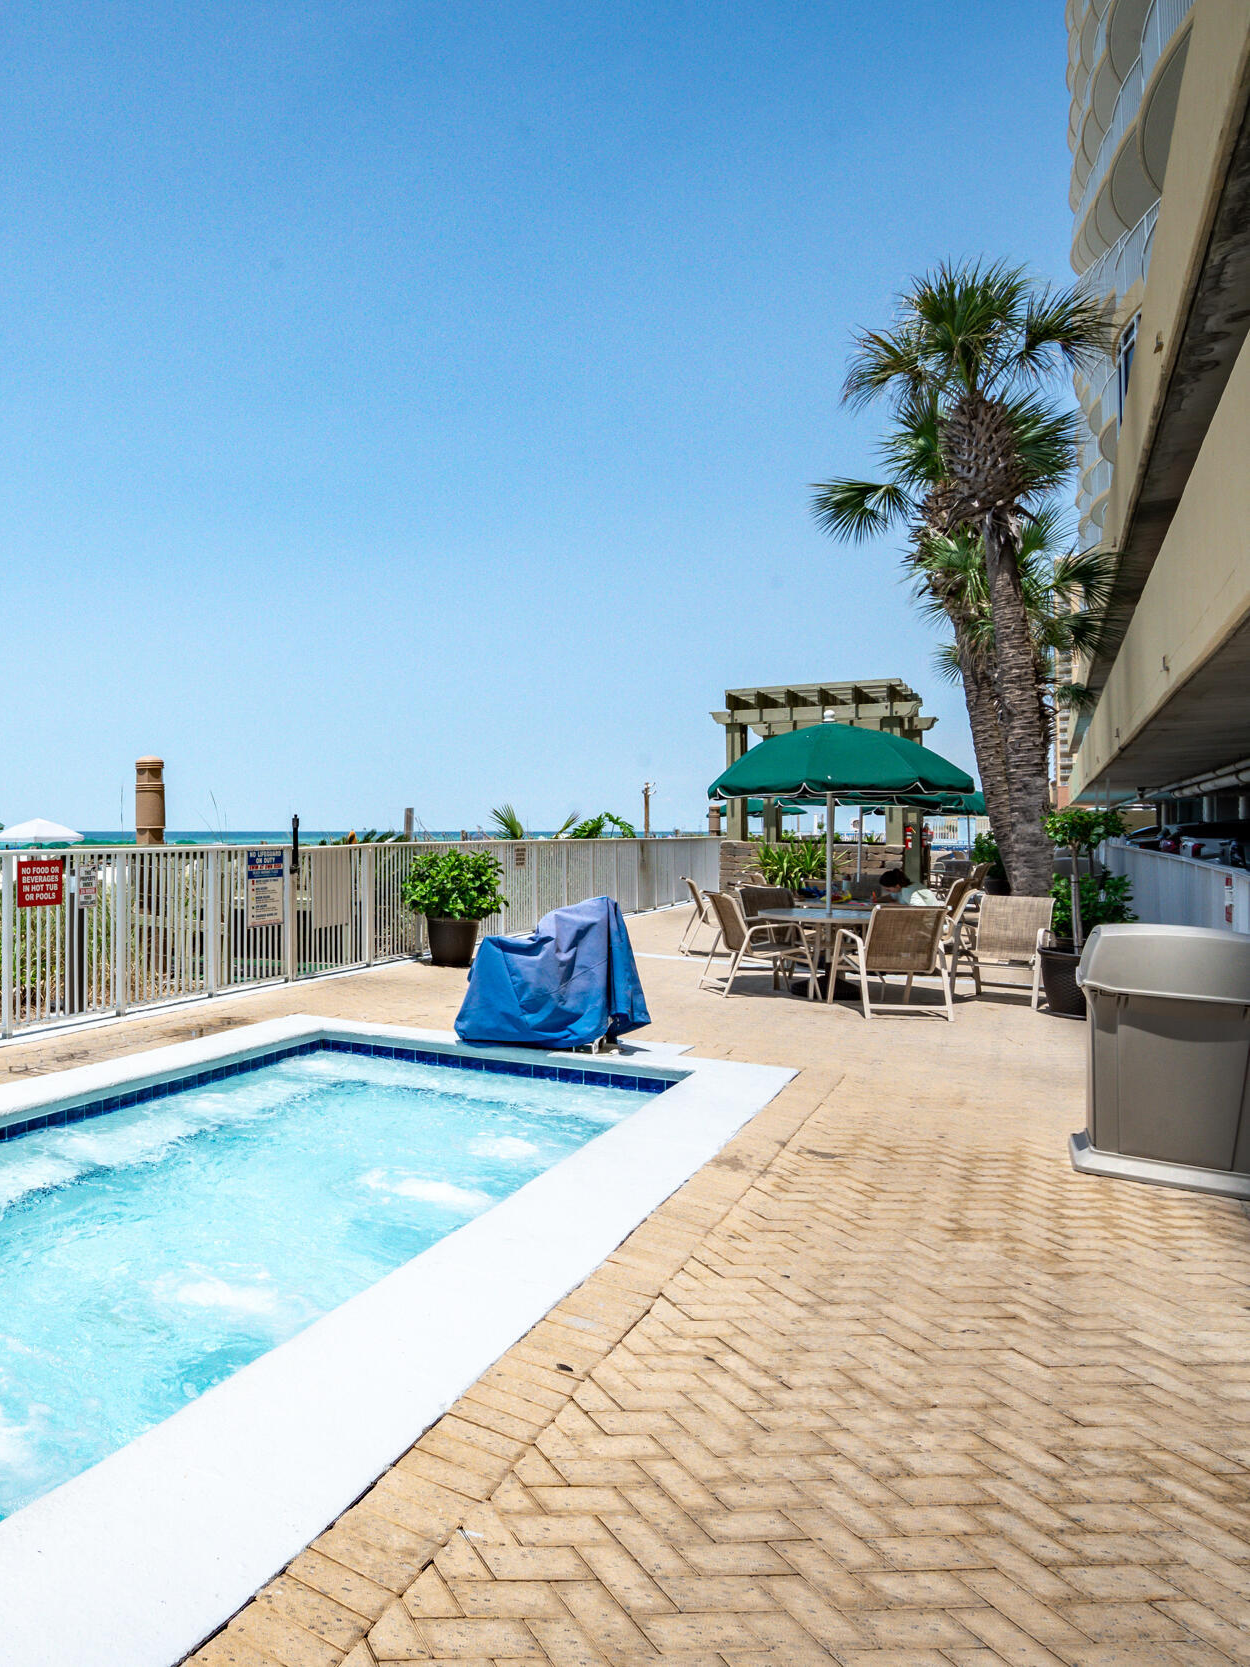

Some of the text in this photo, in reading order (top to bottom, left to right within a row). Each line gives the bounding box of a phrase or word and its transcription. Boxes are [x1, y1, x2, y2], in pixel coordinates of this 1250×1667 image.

[22, 866, 60, 875] NO FOOD OR
[22, 875, 59, 884] BEVERAGES
[31, 884, 44, 892] HOT
[46, 883, 58, 891] TUB
[25, 892, 56, 901] OR POOLS
